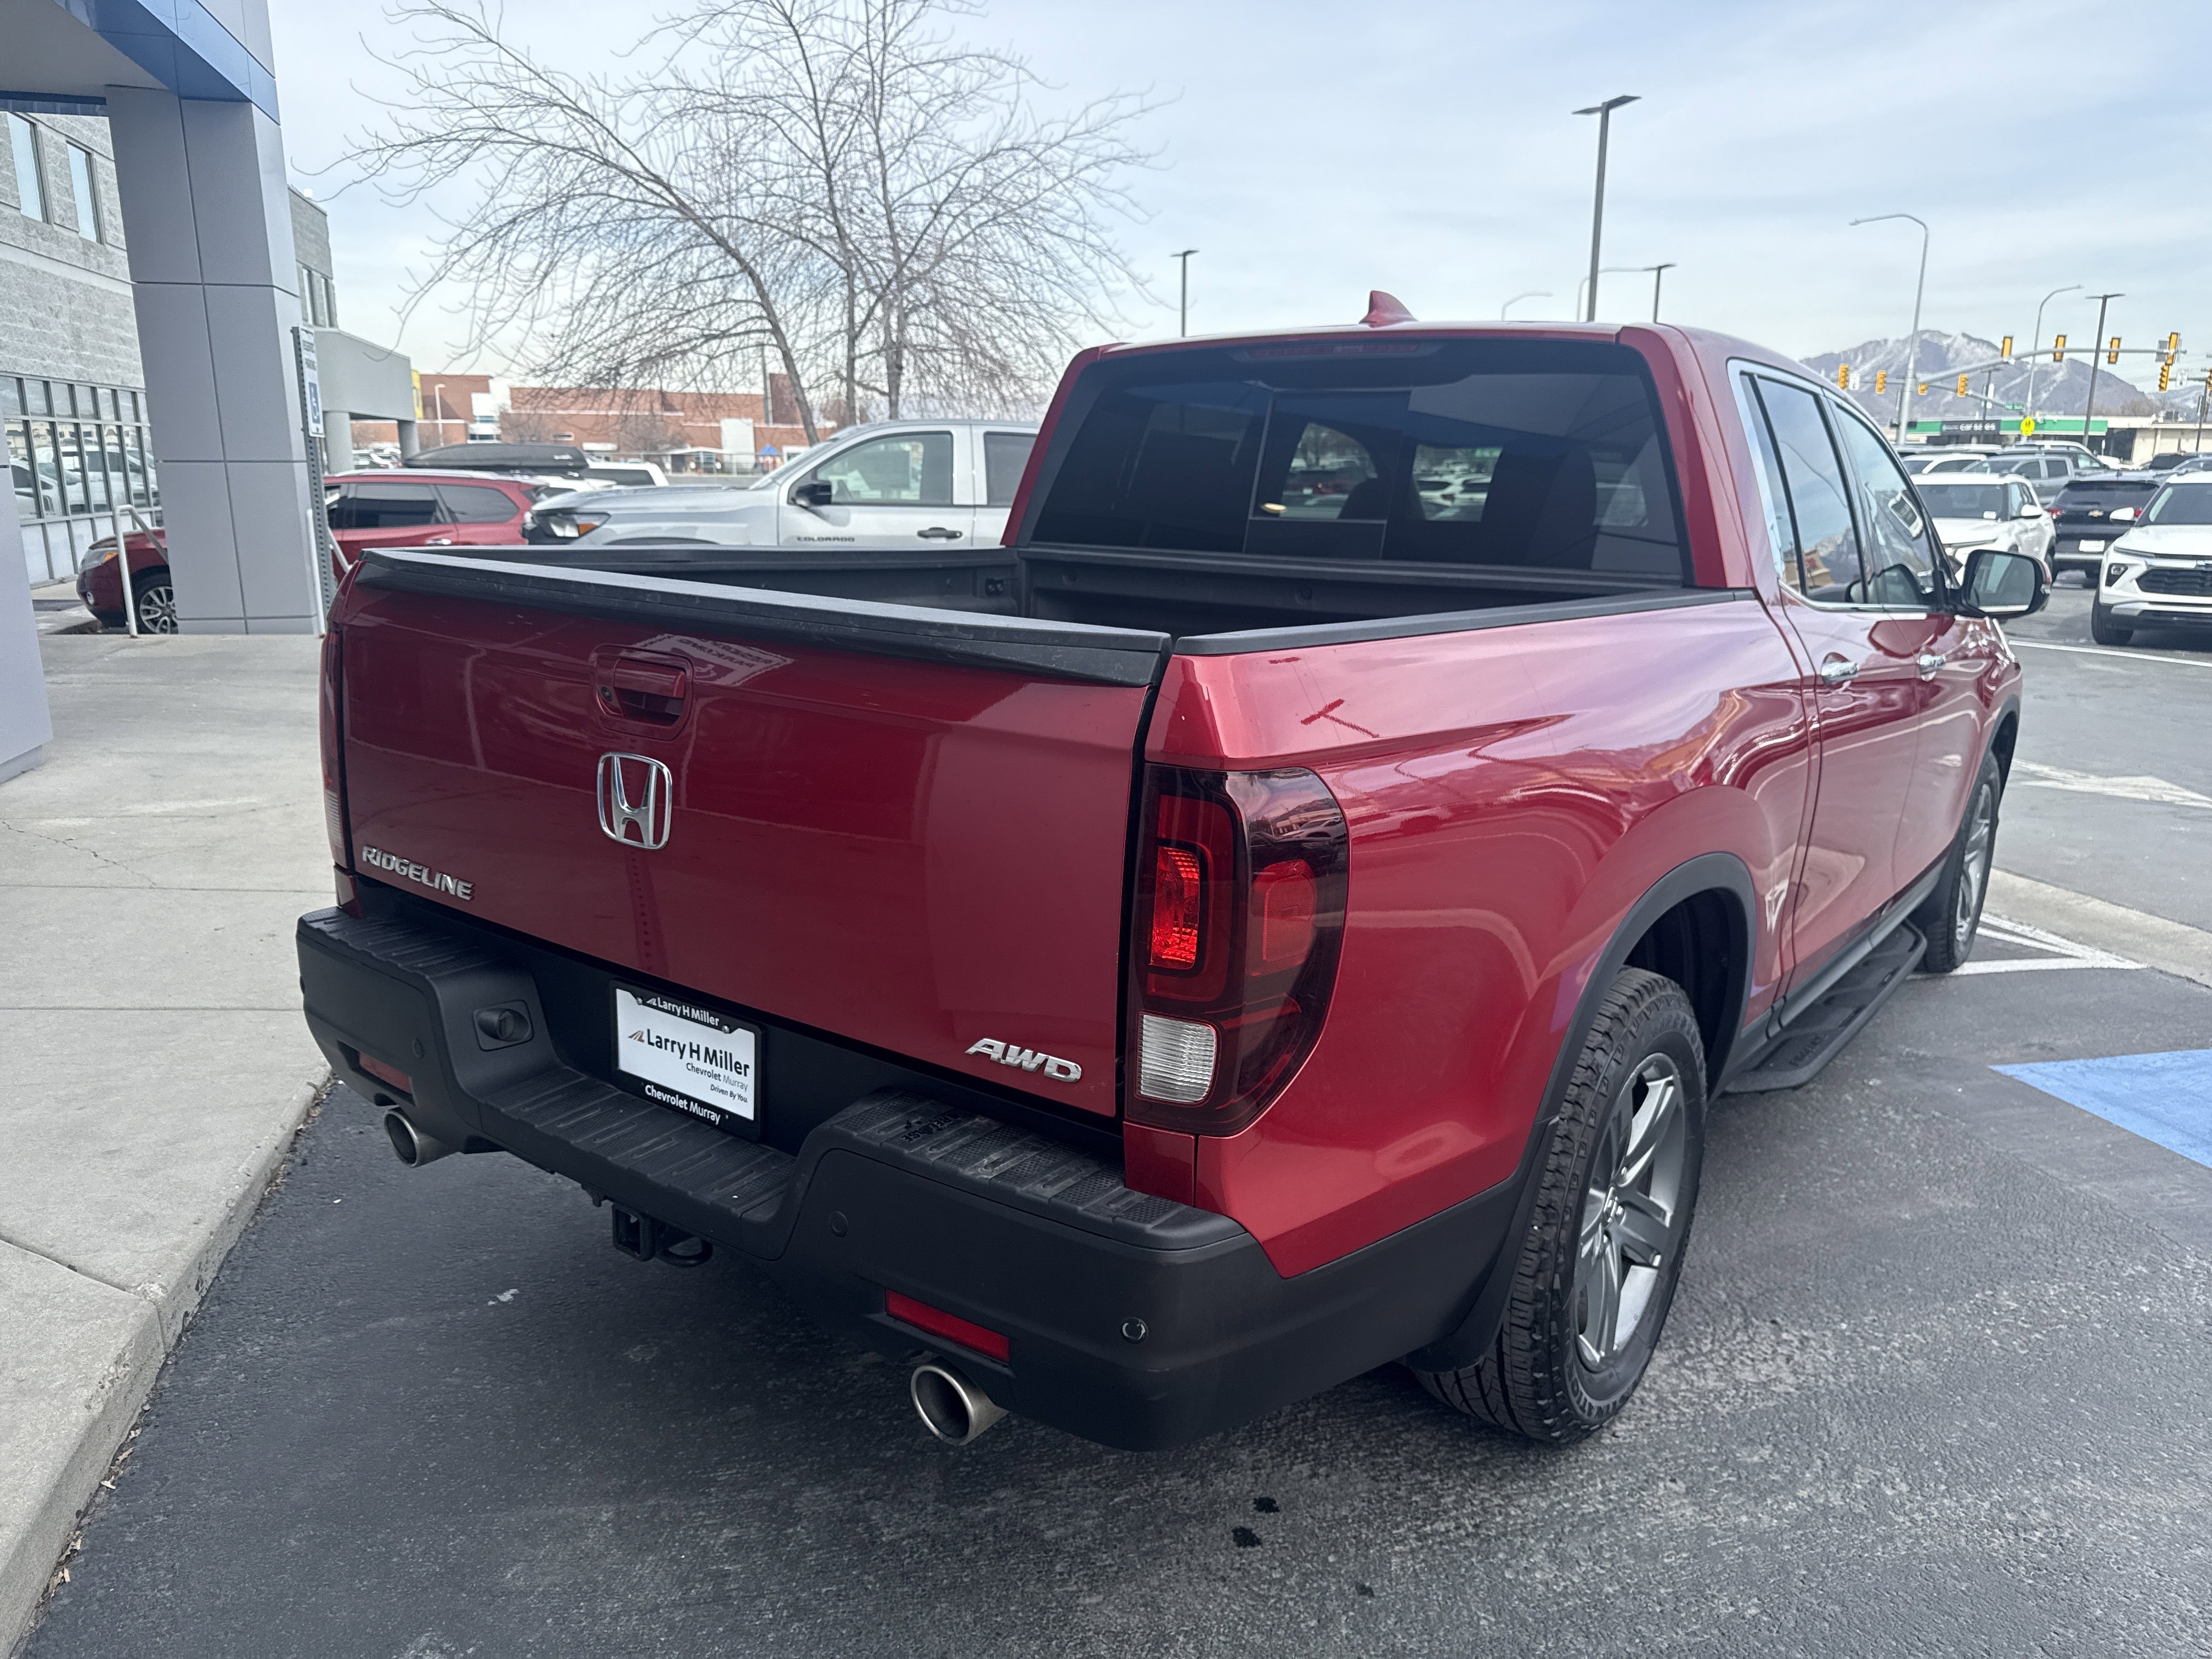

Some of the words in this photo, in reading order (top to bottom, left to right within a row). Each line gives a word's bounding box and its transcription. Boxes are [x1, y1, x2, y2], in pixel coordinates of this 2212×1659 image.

[362, 845, 474, 900] RIDGELINE
[658, 997, 681, 1015] Larry
[683, 1005, 690, 1017] H
[691, 1010, 719, 1026] Miller
[647, 1029, 686, 1059] Larry
[690, 1042, 700, 1060] H
[704, 1047, 749, 1076] Miller
[964, 1038, 1082, 1082] AWD
[686, 1063, 721, 1081] Chevrolet
[723, 1075, 748, 1092] Murray
[710, 1085, 728, 1096] Driven
[730, 1091, 737, 1099] By
[645, 1085, 688, 1109] Chevrolet
[689, 1101, 721, 1125] Murray
[900, 1113, 953, 1142] RELASE
